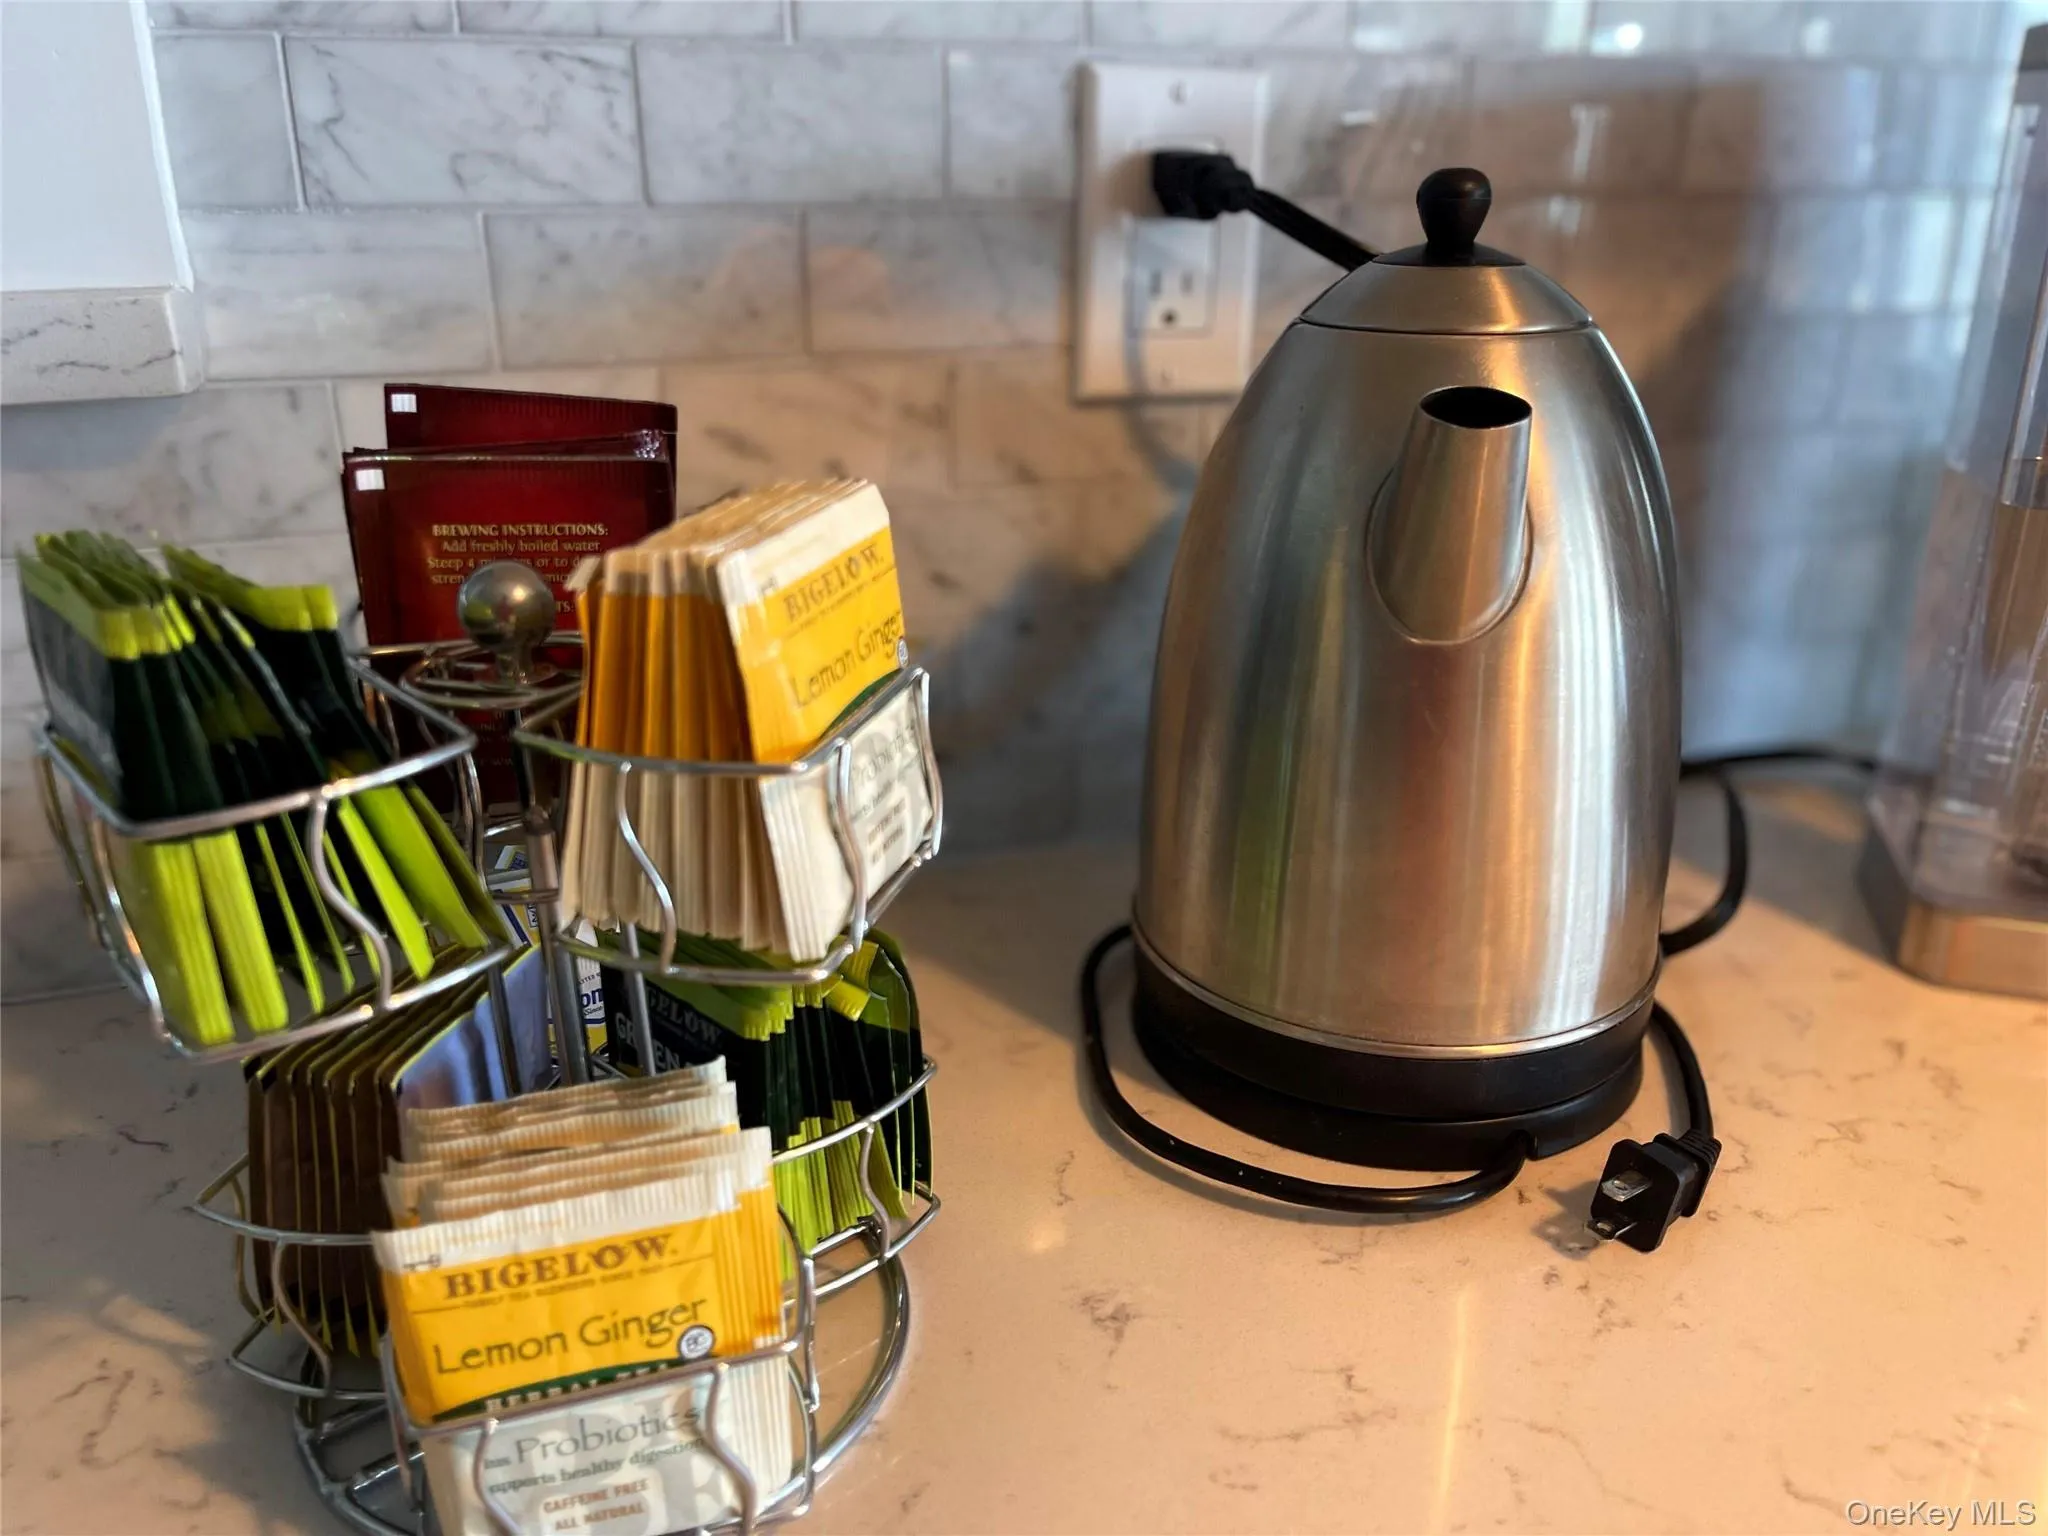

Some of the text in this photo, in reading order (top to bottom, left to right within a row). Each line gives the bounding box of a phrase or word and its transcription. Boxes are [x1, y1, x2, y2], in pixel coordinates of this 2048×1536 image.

[431, 522, 609, 537] BREWING INSTRUCTIONS:
[442, 540, 467, 552] Add
[471, 539, 516, 555] freshly
[519, 538, 559, 552] boiled
[427, 557, 464, 570] Steep
[535, 559, 551, 569] or
[555, 557, 569, 569] to
[791, 648, 858, 708] Lemon
[433, 1297, 708, 1374] Lemon Ginger
[515, 1408, 702, 1463] Probiotics
[560, 1458, 625, 1481] healthy
[630, 1438, 704, 1467] digestion
[543, 1478, 650, 1514] CAFFEINE FREE
[555, 1503, 645, 1530] ALL NATURAL
